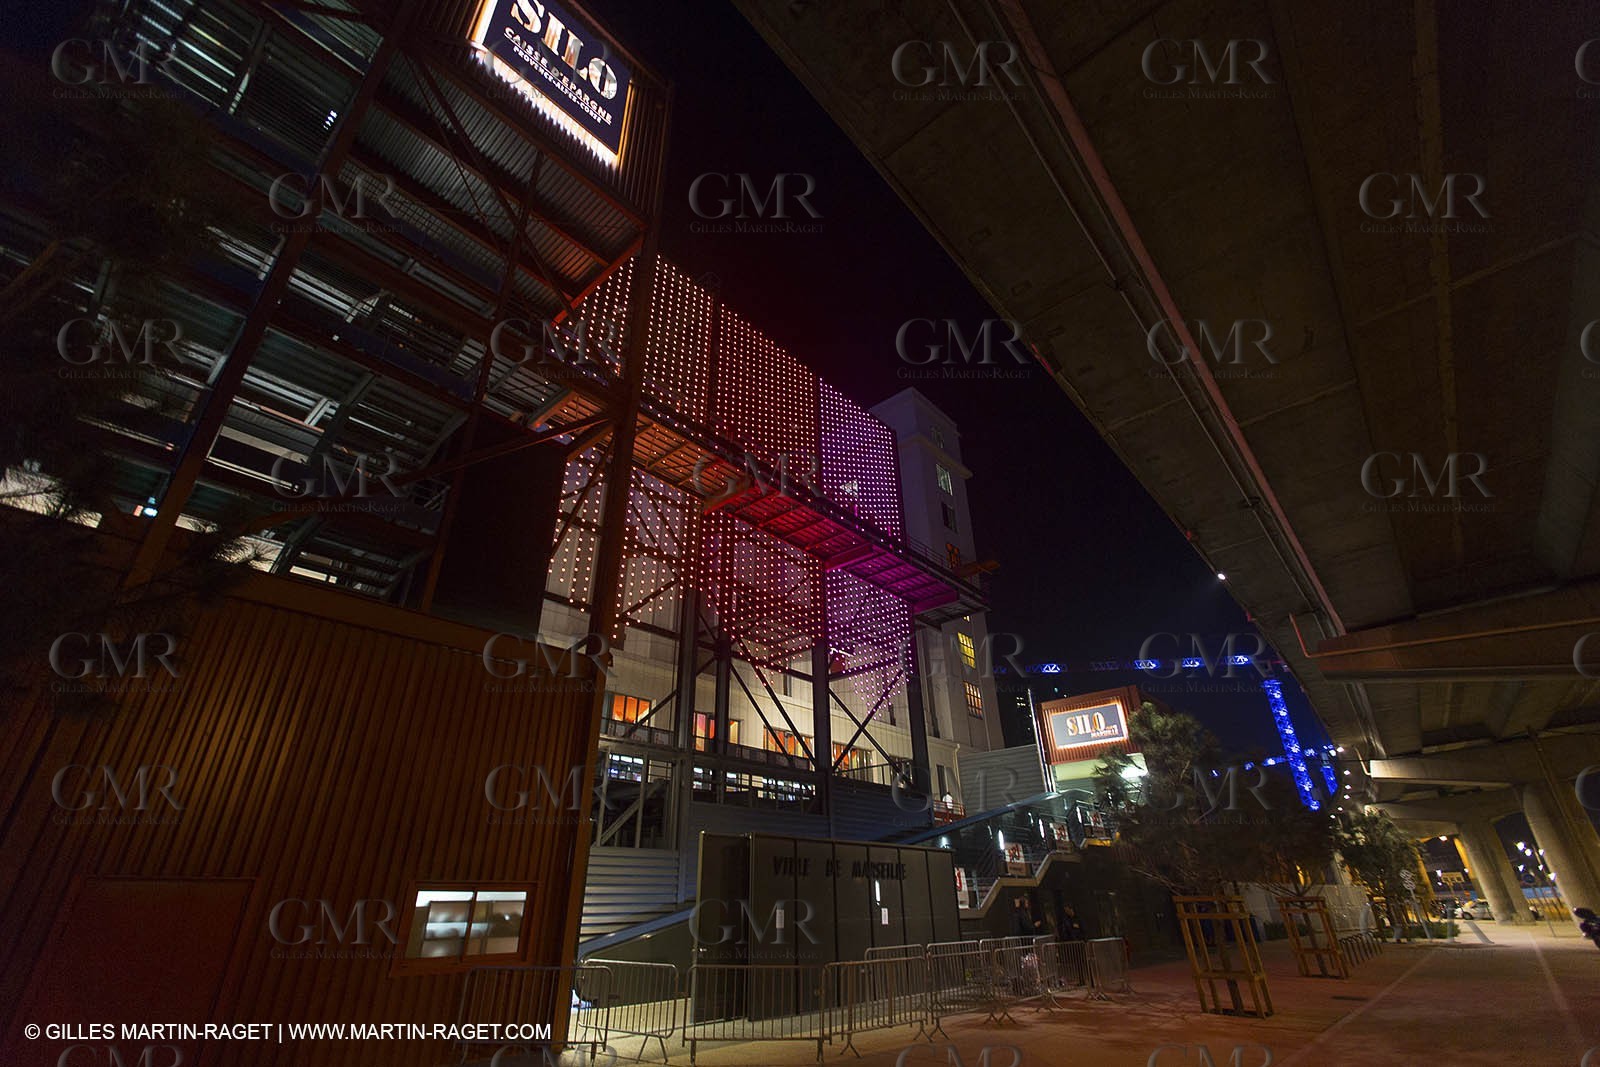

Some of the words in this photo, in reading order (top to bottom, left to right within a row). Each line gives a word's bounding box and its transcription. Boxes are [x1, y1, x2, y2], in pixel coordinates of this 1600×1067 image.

[504, 27, 550, 68] CAISSE
[550, 66, 613, 122] D'EPARGNE
[510, 0, 618, 100] SILO
[1066, 711, 1106, 737] SILO
